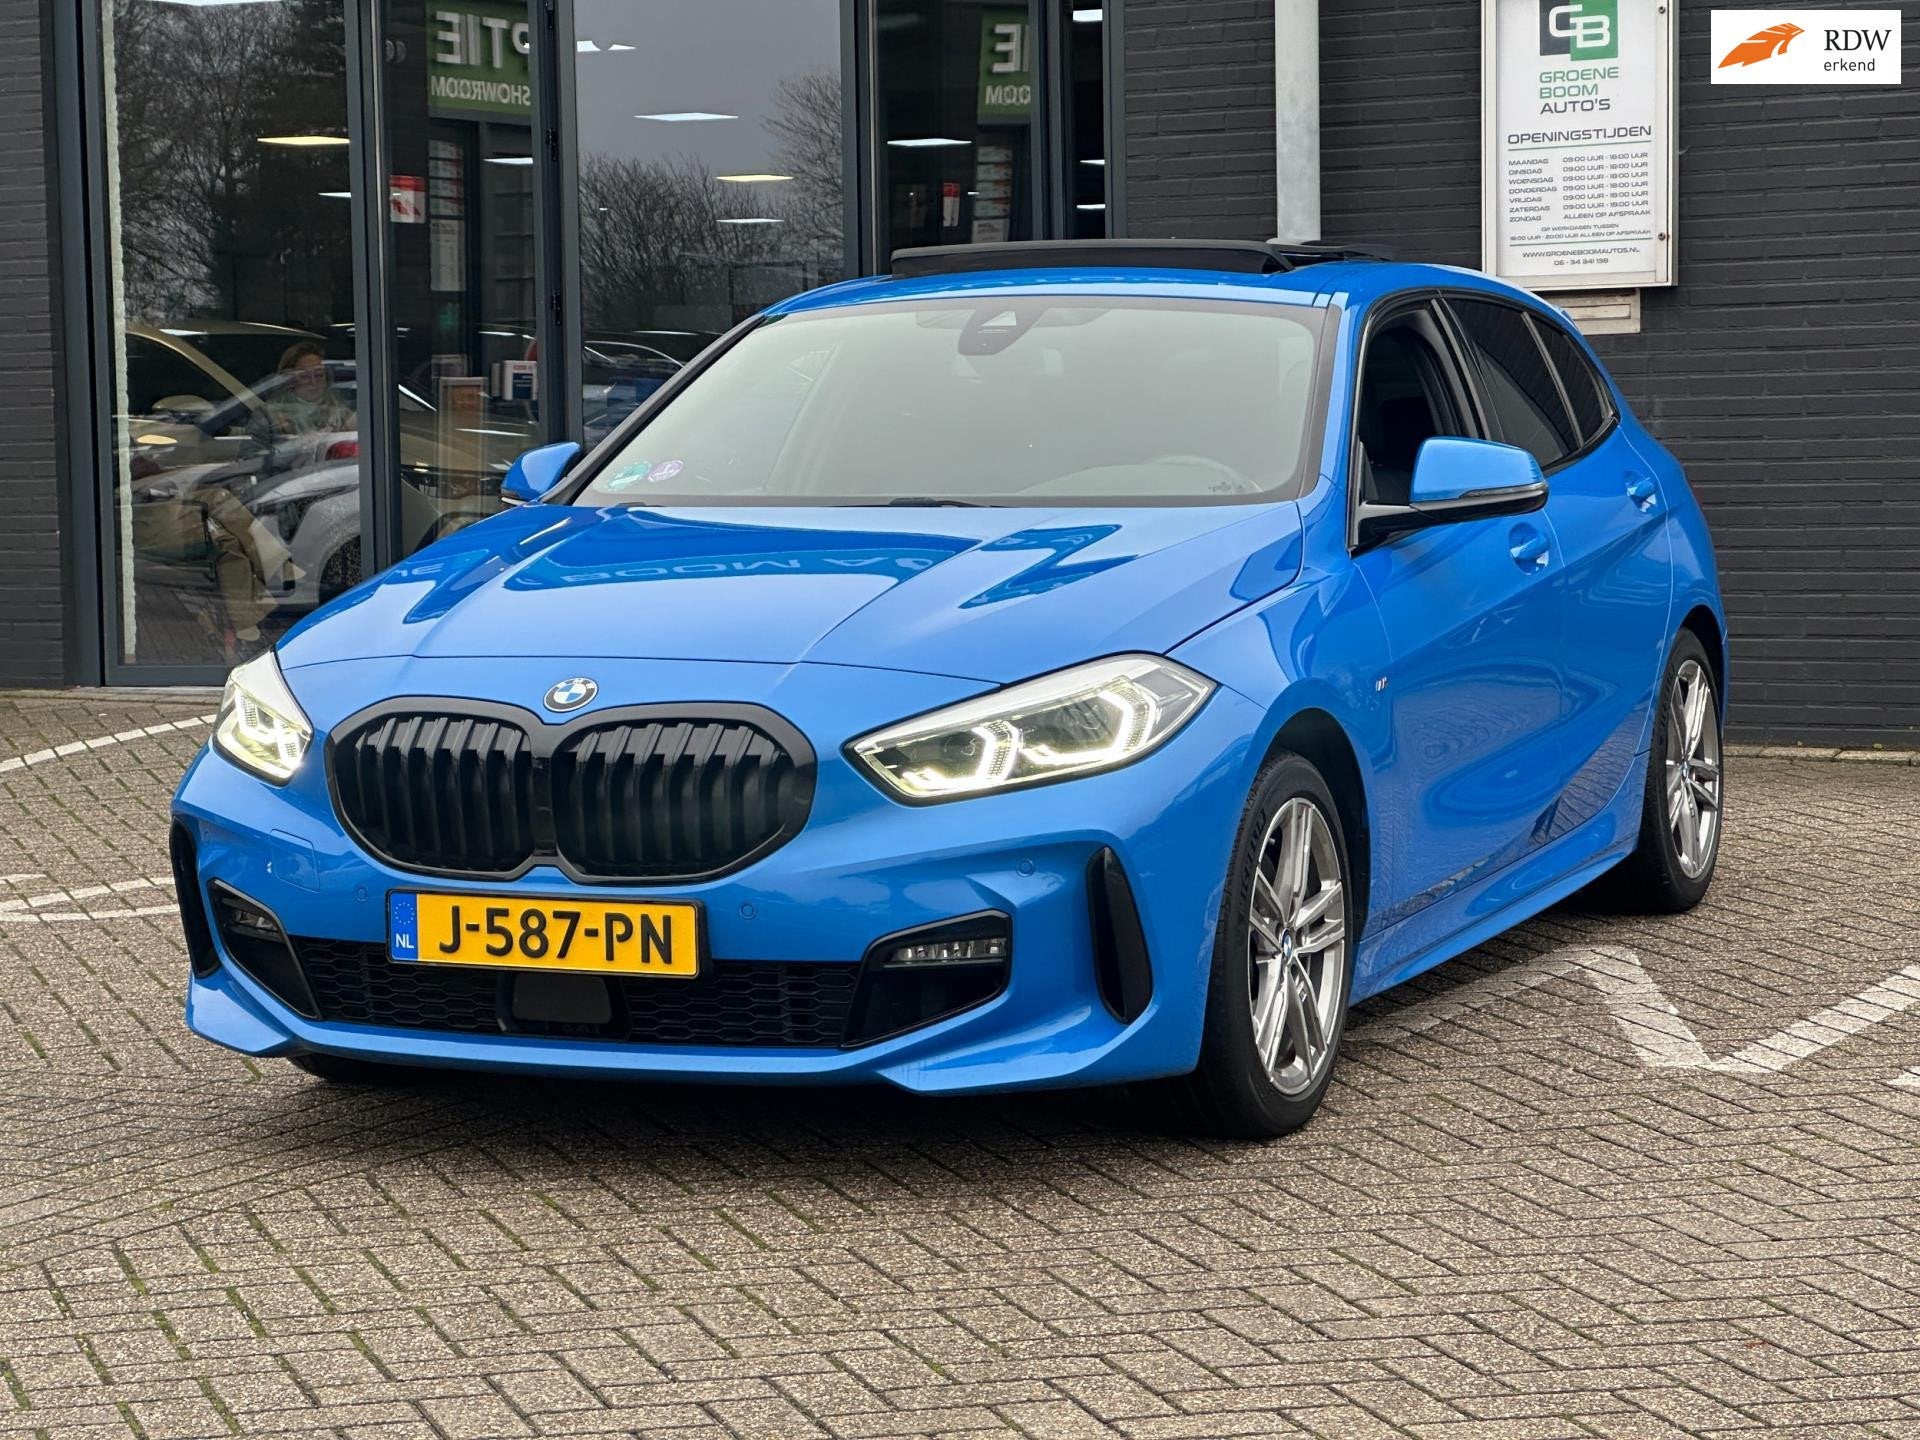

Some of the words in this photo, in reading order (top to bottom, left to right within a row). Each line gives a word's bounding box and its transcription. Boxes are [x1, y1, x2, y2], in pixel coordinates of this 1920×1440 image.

[1539, 66, 1619, 84] GROENE
[1540, 83, 1598, 99] BOOM
[1540, 98, 1611, 115] AUTO'S
[1507, 125, 1652, 144] OPENINGSTIJDEN
[1508, 158, 1549, 166] MAANDAG
[1508, 186, 1557, 194] DONDERDAG
[1509, 205, 1550, 213] ZATERDAG
[395, 933, 415, 949] NL
[439, 905, 673, 965] J-587-PN
